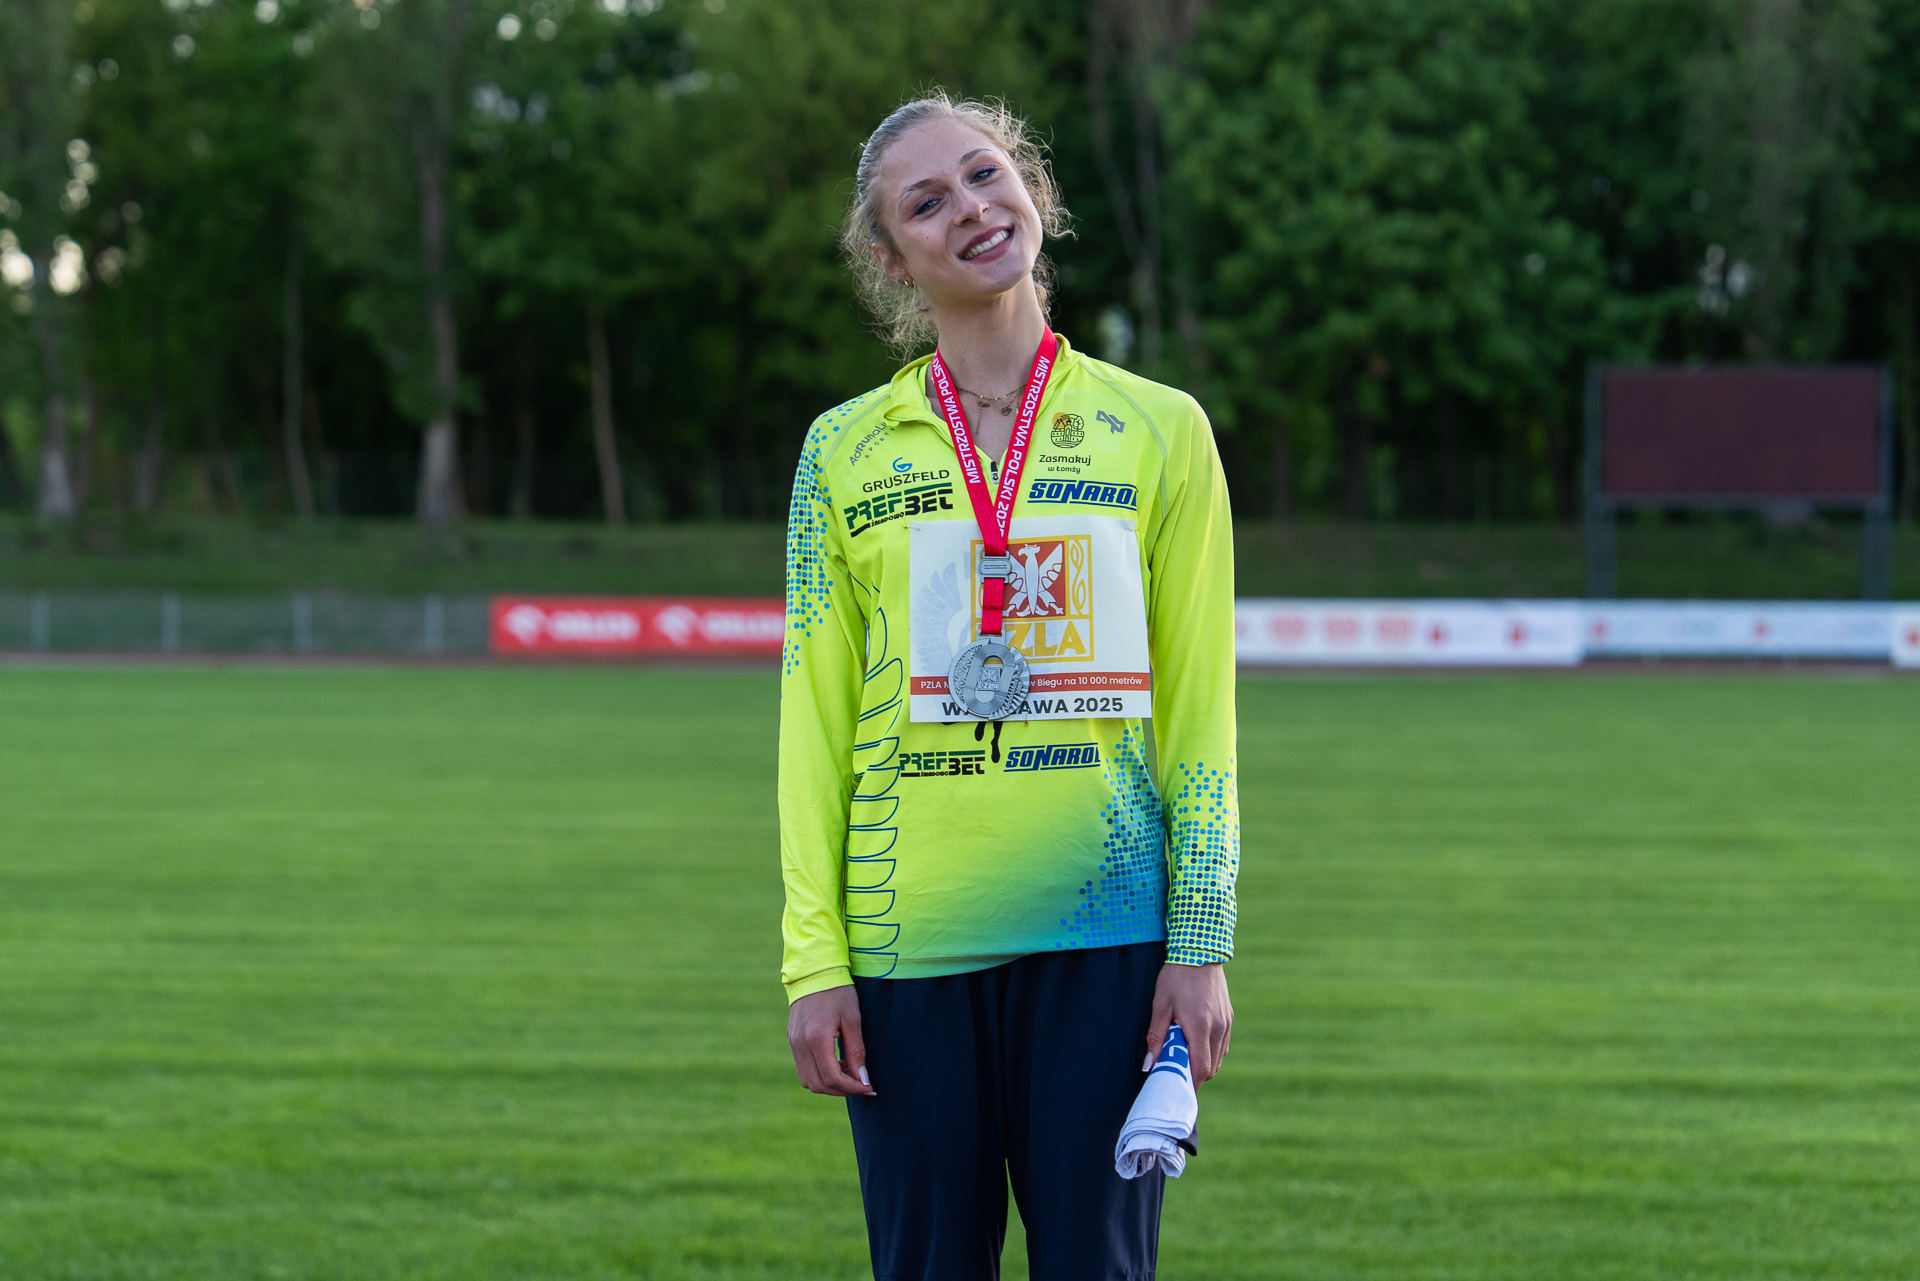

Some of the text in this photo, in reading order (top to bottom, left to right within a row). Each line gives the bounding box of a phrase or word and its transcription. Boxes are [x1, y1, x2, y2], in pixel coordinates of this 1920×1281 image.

[1013, 355, 1051, 447] MISTRZOSTWA
[932, 357, 982, 484] MISTRZOSTWA POLSKI
[1039, 454, 1092, 466] Zasmakuj
[862, 469, 950, 493] GRUSZFELD
[1000, 449, 1023, 501] POLSKI
[1004, 620, 1088, 657] ZLA
[920, 681, 942, 689] PZLA
[1037, 678, 1062, 688] Biegu
[1078, 676, 1088, 685] 10
[1090, 676, 1108, 685] 000
[1109, 676, 1143, 685] metrów
[942, 697, 1124, 716] WAWA 2025
